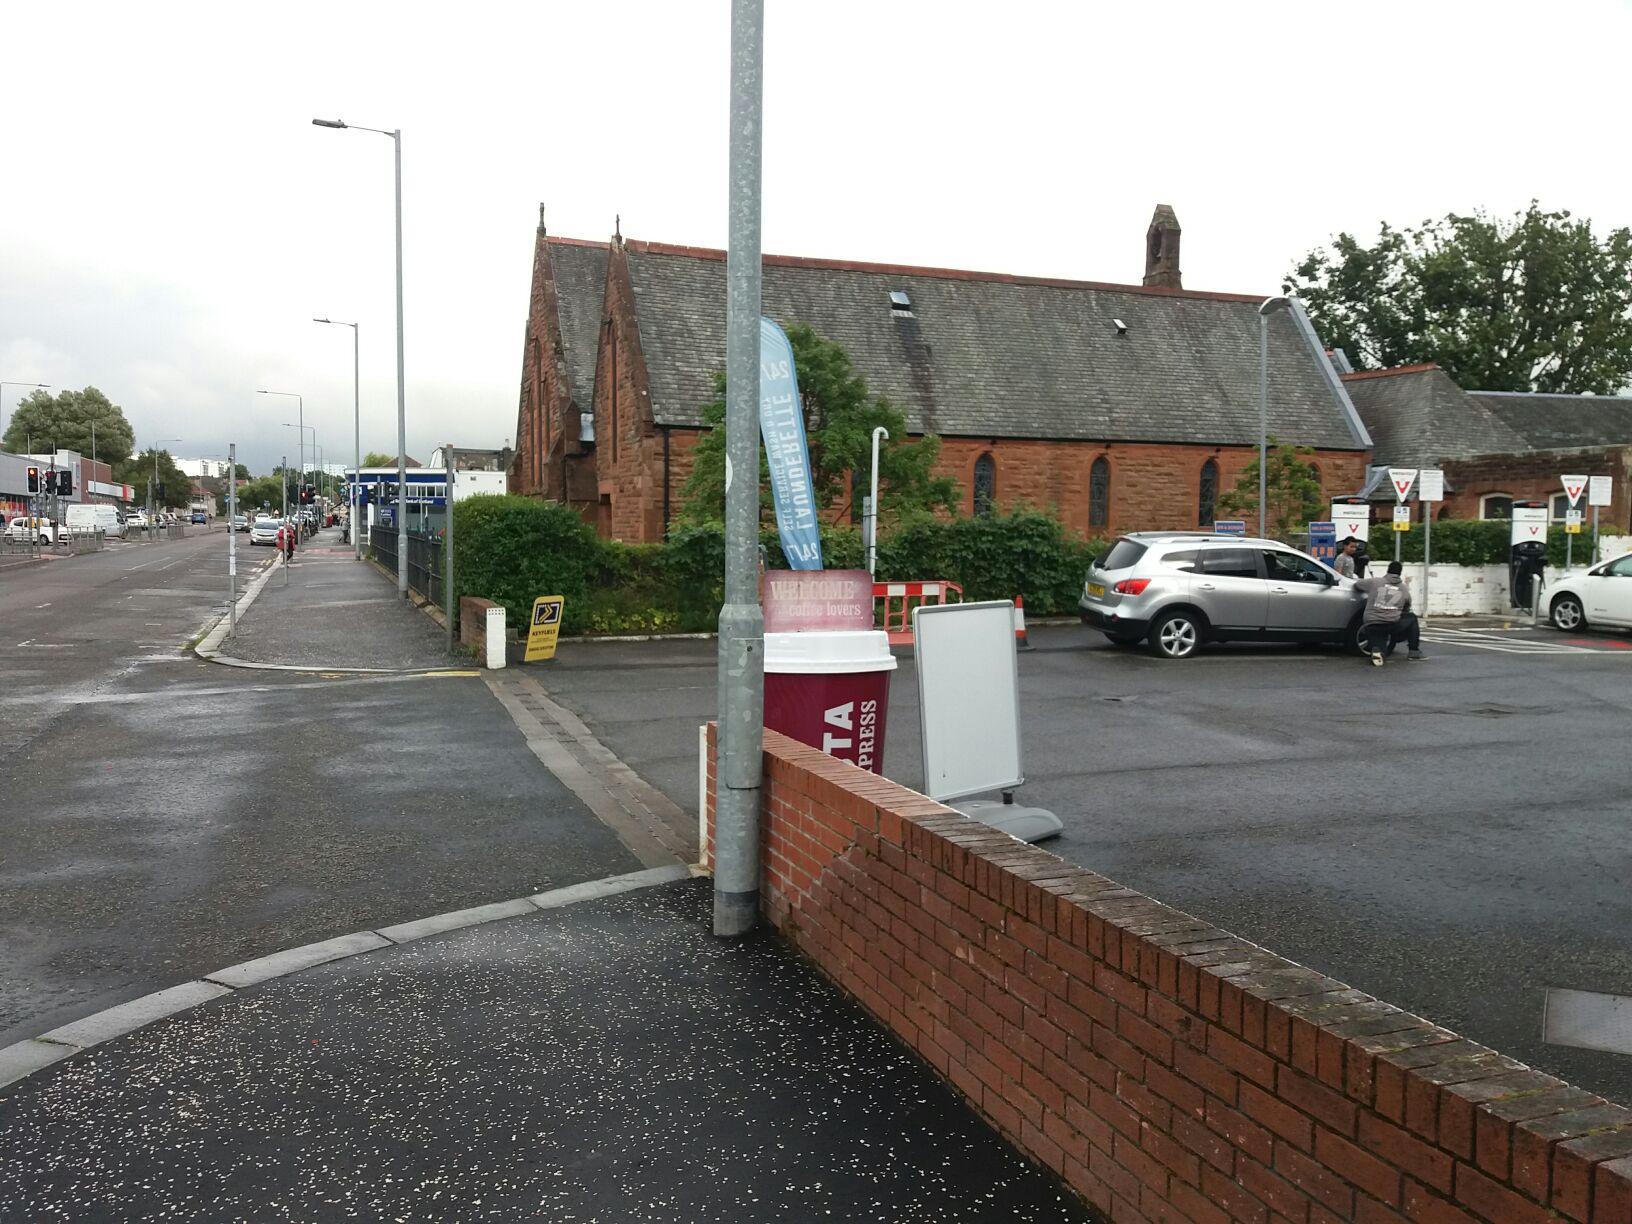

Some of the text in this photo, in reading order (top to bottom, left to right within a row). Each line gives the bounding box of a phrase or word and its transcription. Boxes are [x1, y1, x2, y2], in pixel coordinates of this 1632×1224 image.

[770, 581, 854, 600] WELCOME
[823, 701, 854, 766] TA
[858, 700, 876, 773] PRESS
